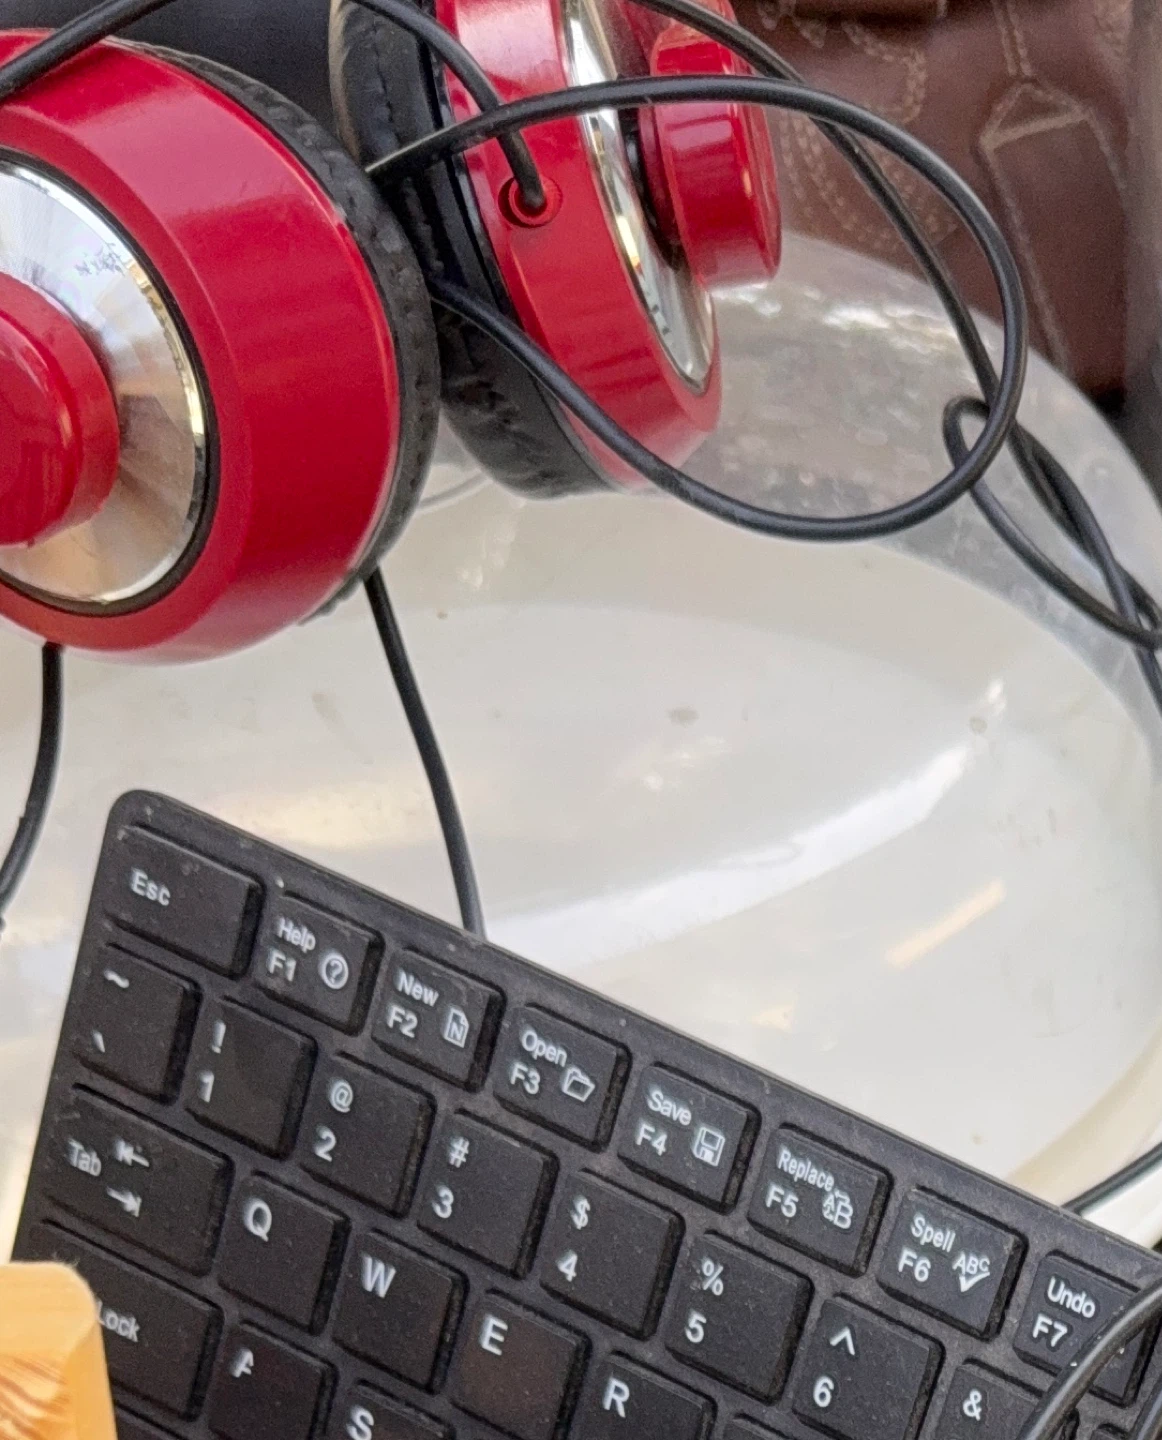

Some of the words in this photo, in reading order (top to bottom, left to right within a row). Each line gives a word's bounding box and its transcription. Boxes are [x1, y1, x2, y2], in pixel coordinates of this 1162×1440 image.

[132, 871, 170, 905] Esc
[279, 919, 315, 951] Help
[270, 951, 296, 980] F1
[395, 972, 438, 1010] New
[388, 1005, 417, 1037] F2
[212, 1022, 226, 1053] !
[517, 1030, 567, 1071] Open
[202, 1073, 214, 1102] 1
[511, 1063, 540, 1094] F3
[330, 1080, 353, 1112] @
[644, 1090, 691, 1129] Save
[316, 1128, 336, 1161] 2
[450, 1138, 469, 1167] #
[637, 1123, 667, 1155] F4
[67, 1138, 102, 1177] Tab
[774, 1149, 834, 1195] Replace
[433, 1187, 453, 1218] 3
[572, 1197, 590, 1229] $
[767, 1185, 798, 1217] F5
[245, 1202, 272, 1241] Q
[908, 1216, 955, 1255] Spell
[363, 1257, 396, 1297] W
[558, 1253, 577, 1281] 4
[702, 1259, 723, 1295] %
[899, 1249, 930, 1281] F6
[1048, 1279, 1095, 1317] Undo
[481, 1316, 507, 1355] E
[686, 1312, 706, 1342] 5
[1033, 1315, 1067, 1346] F7
[604, 1378, 629, 1417] R
[814, 1377, 834, 1407] 6
[963, 1390, 981, 1420] &
